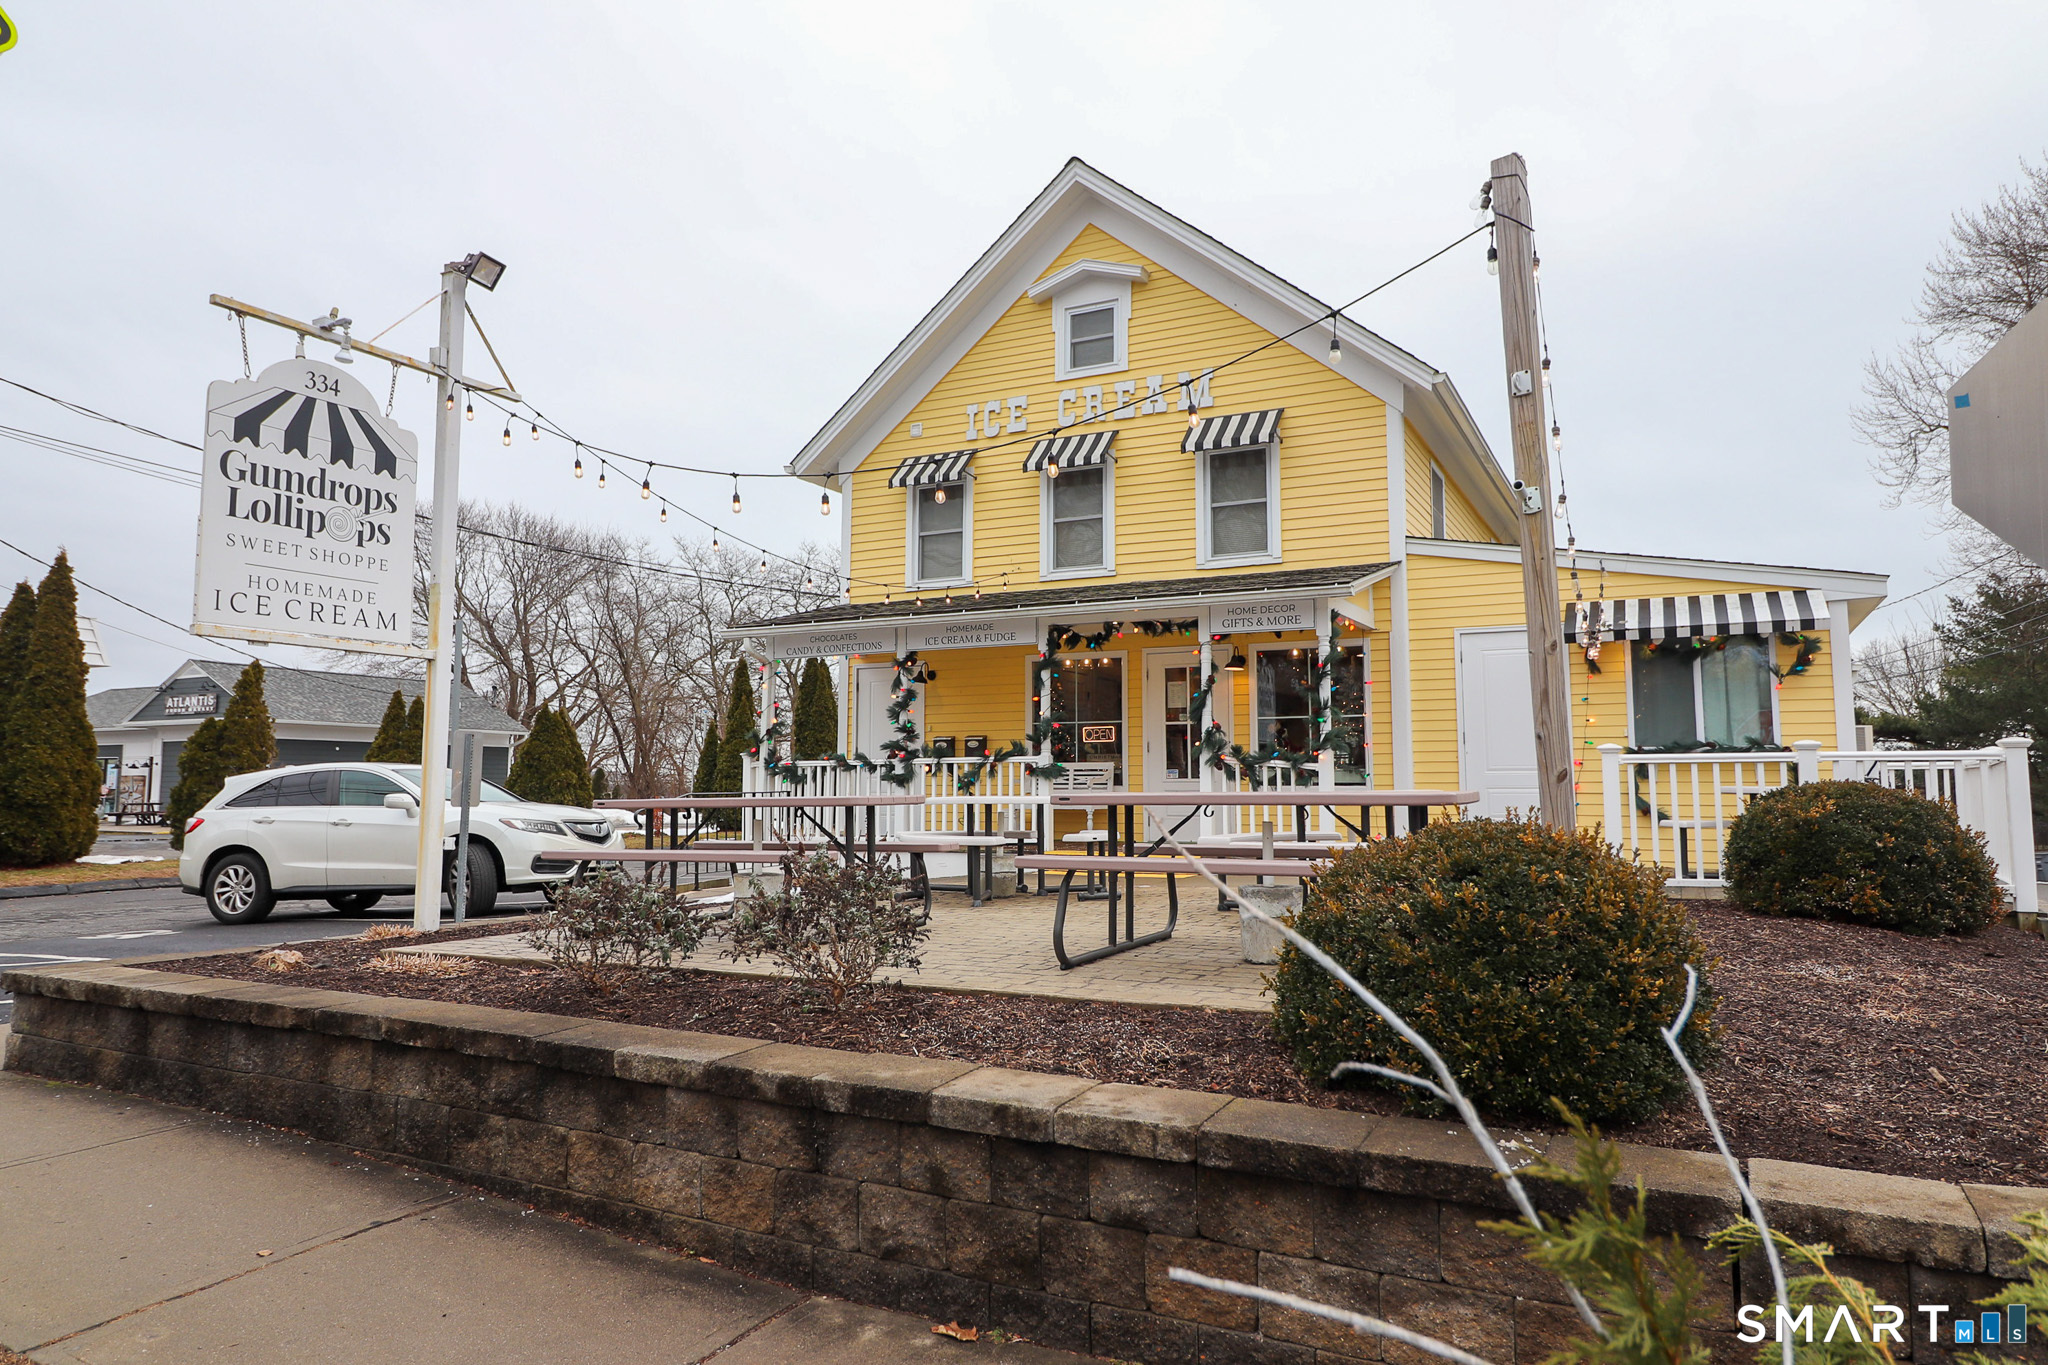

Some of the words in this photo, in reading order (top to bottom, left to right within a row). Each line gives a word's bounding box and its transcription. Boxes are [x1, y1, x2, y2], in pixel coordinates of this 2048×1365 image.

[304, 371, 341, 397] 334
[965, 395, 1028, 441] ICE
[1057, 368, 1214, 427] CREAM
[219, 449, 399, 516] Gumdrops
[226, 533, 303, 557] SWEET
[309, 547, 389, 572] SHOPPE
[248, 574, 377, 605] HOMEMADE
[213, 588, 272, 617] ICE
[284, 598, 398, 631] CREAM
[1227, 606, 1257, 616] HOME
[1260, 604, 1296, 614] DECOR
[945, 623, 994, 633] HOMEMADE
[1222, 617, 1254, 628] GIFTS
[1256, 617, 1264, 627] &
[1266, 615, 1302, 626] MORE
[809, 632, 858, 643] CHOCOLATES
[924, 636, 939, 646] ICE
[941, 634, 974, 645] CREAM
[975, 634, 982, 643] &
[984, 632, 1017, 643] FUDGE
[786, 646, 815, 656] CANDY
[816, 645, 822, 654] &
[823, 641, 883, 653] CONFECTIONS
[166, 695, 215, 708] ATLANTIS
[1085, 728, 1113, 741] OPEN
